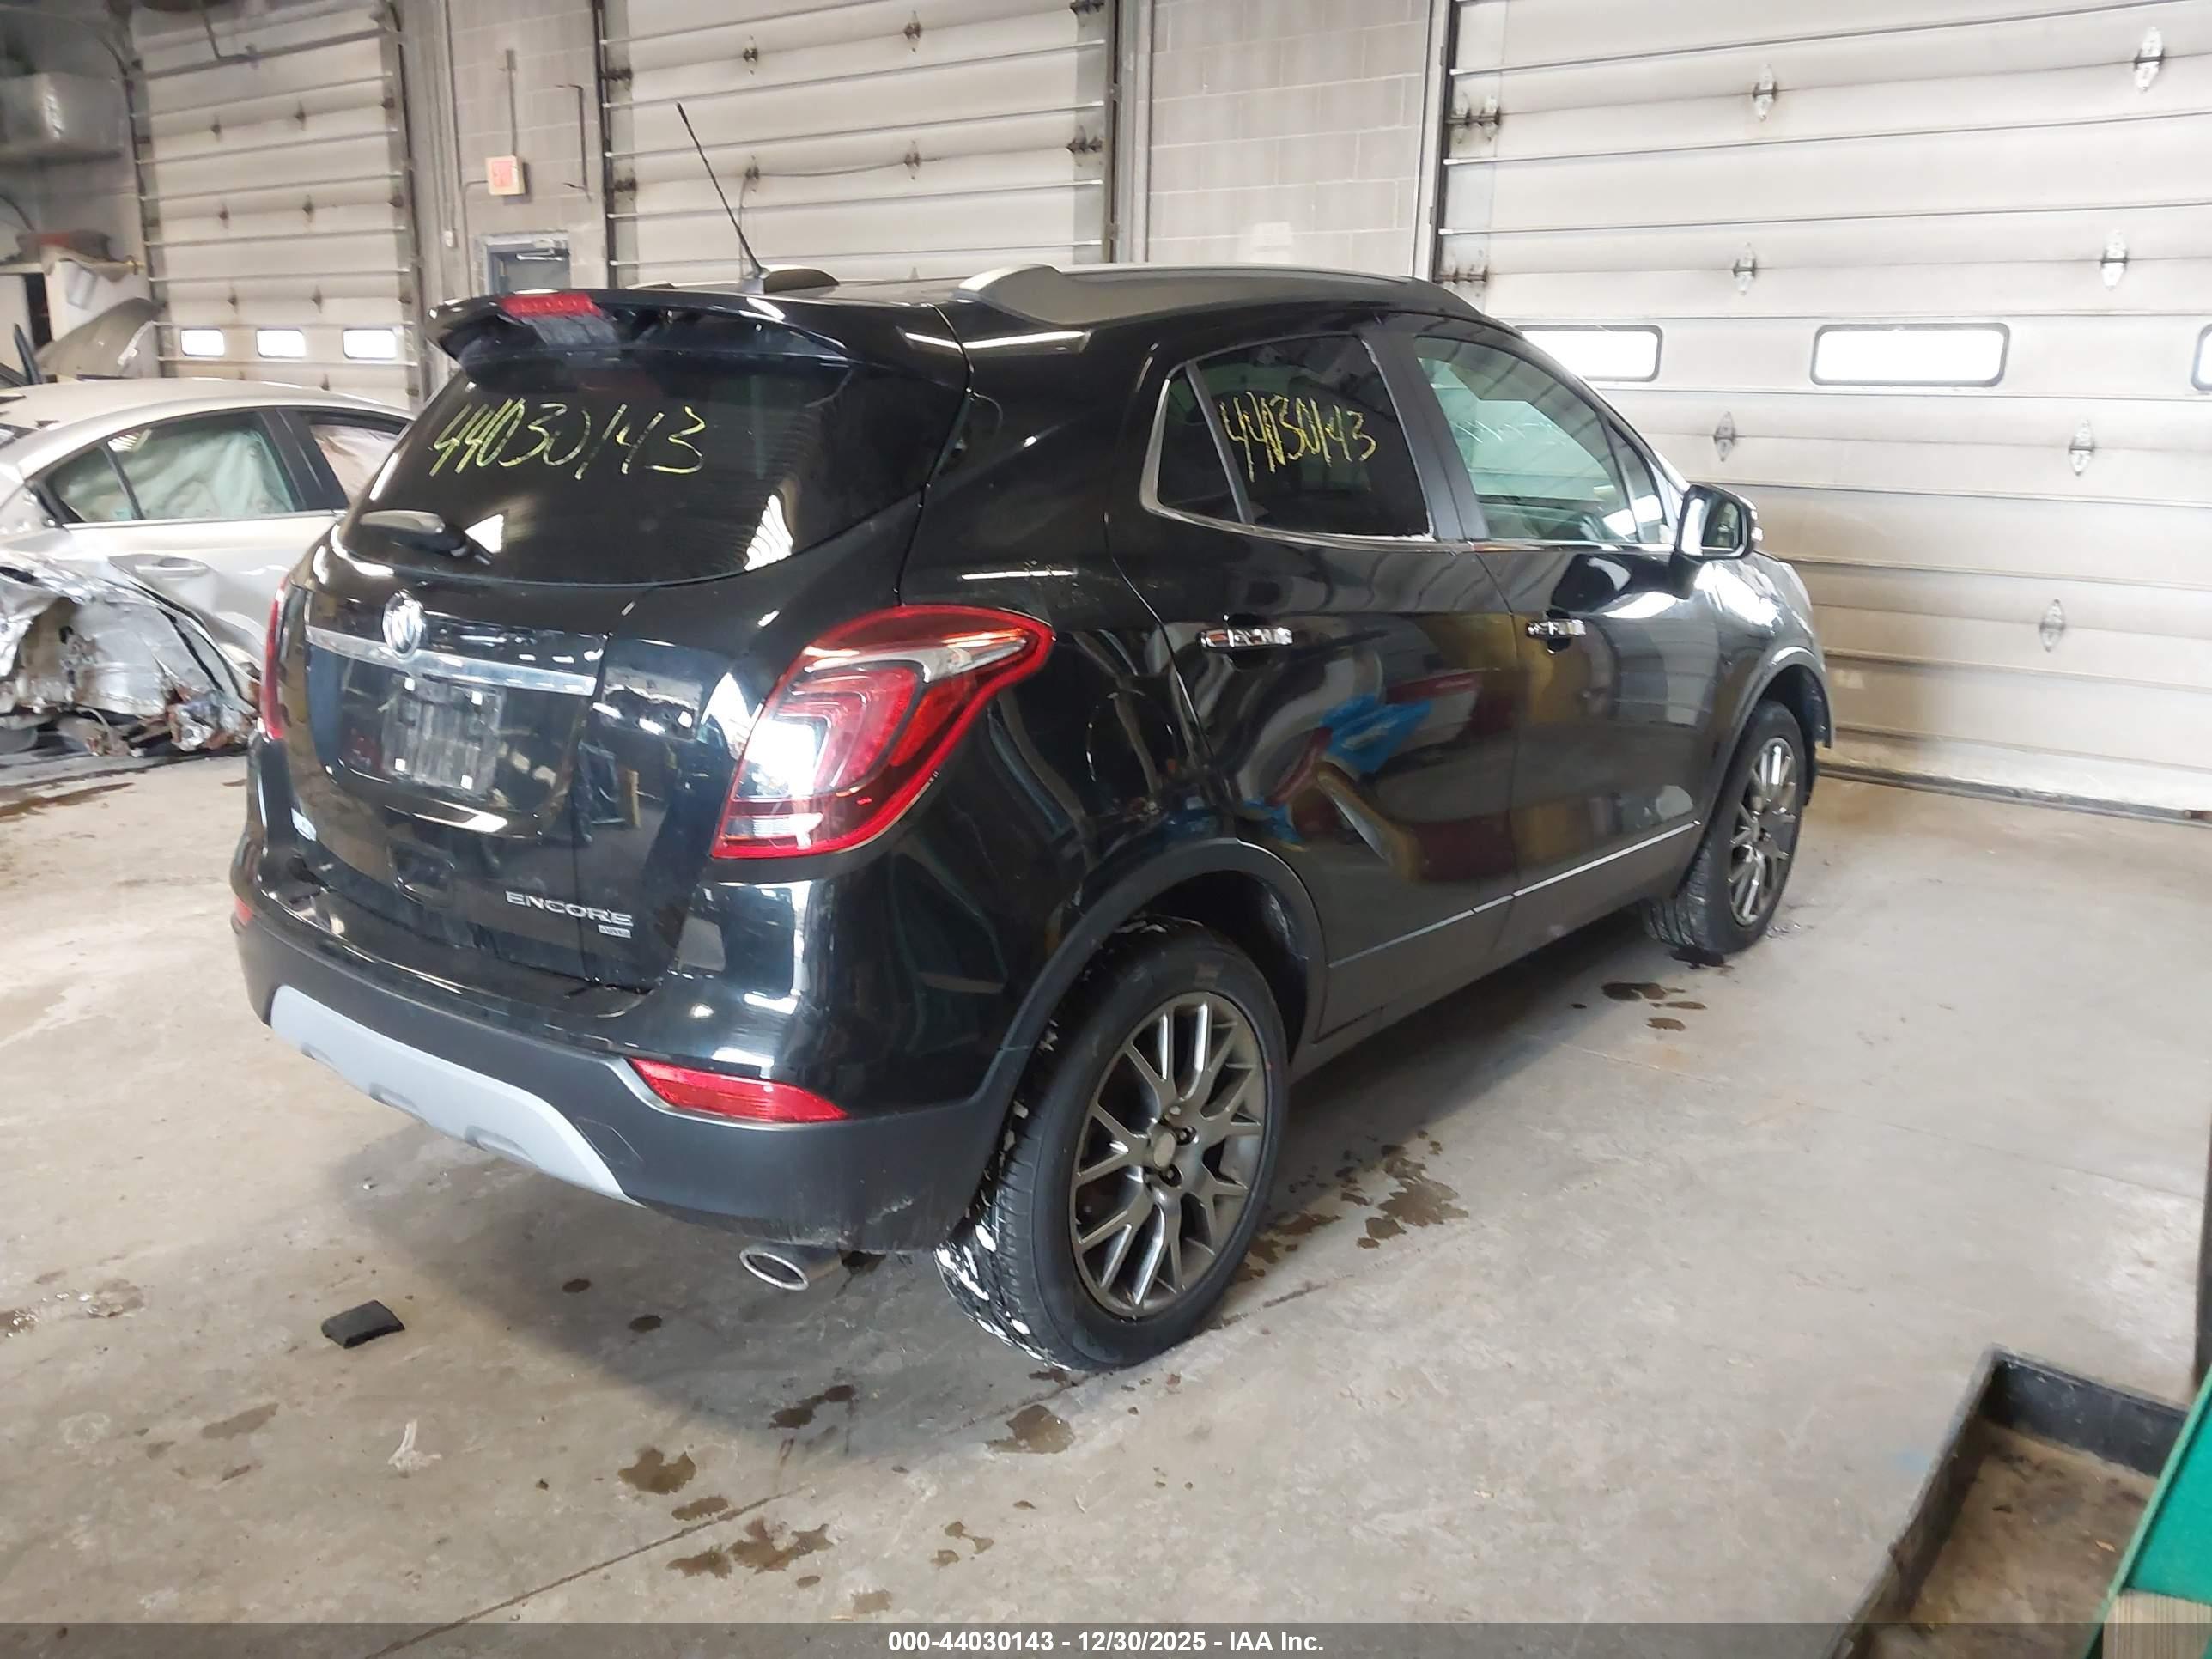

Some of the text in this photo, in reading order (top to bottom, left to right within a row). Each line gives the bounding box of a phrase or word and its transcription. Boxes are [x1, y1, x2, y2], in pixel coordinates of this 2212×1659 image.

[428, 398, 706, 479] 44030143
[1219, 391, 1377, 483] 44030143
[505, 890, 634, 927] ENCORE
